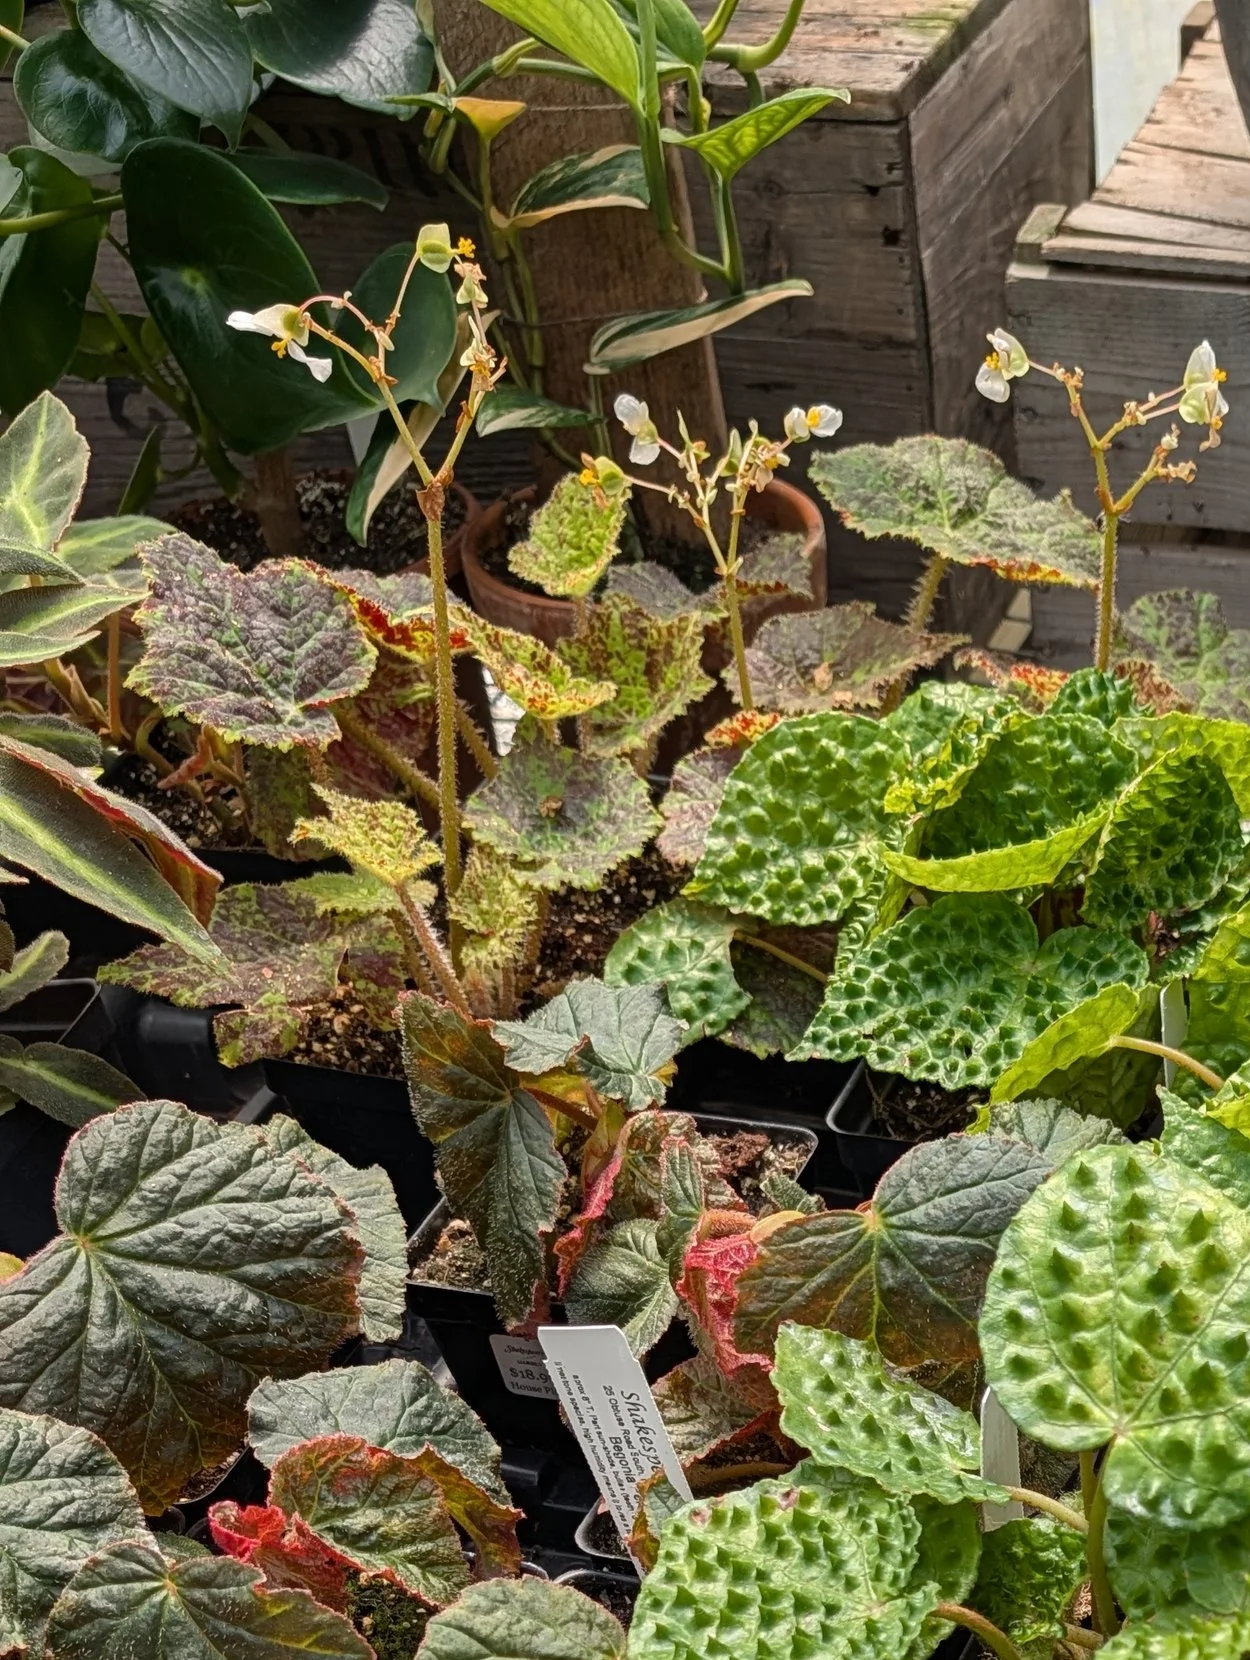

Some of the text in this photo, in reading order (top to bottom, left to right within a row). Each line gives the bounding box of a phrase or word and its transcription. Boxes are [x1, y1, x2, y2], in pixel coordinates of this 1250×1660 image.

[510, 1367, 549, 1383] $18.9
[603, 1385, 616, 1397] 25
[609, 1398, 625, 1427] Obtuse
[621, 1428, 637, 1450] Road
[609, 1436, 636, 1483] Begonia
